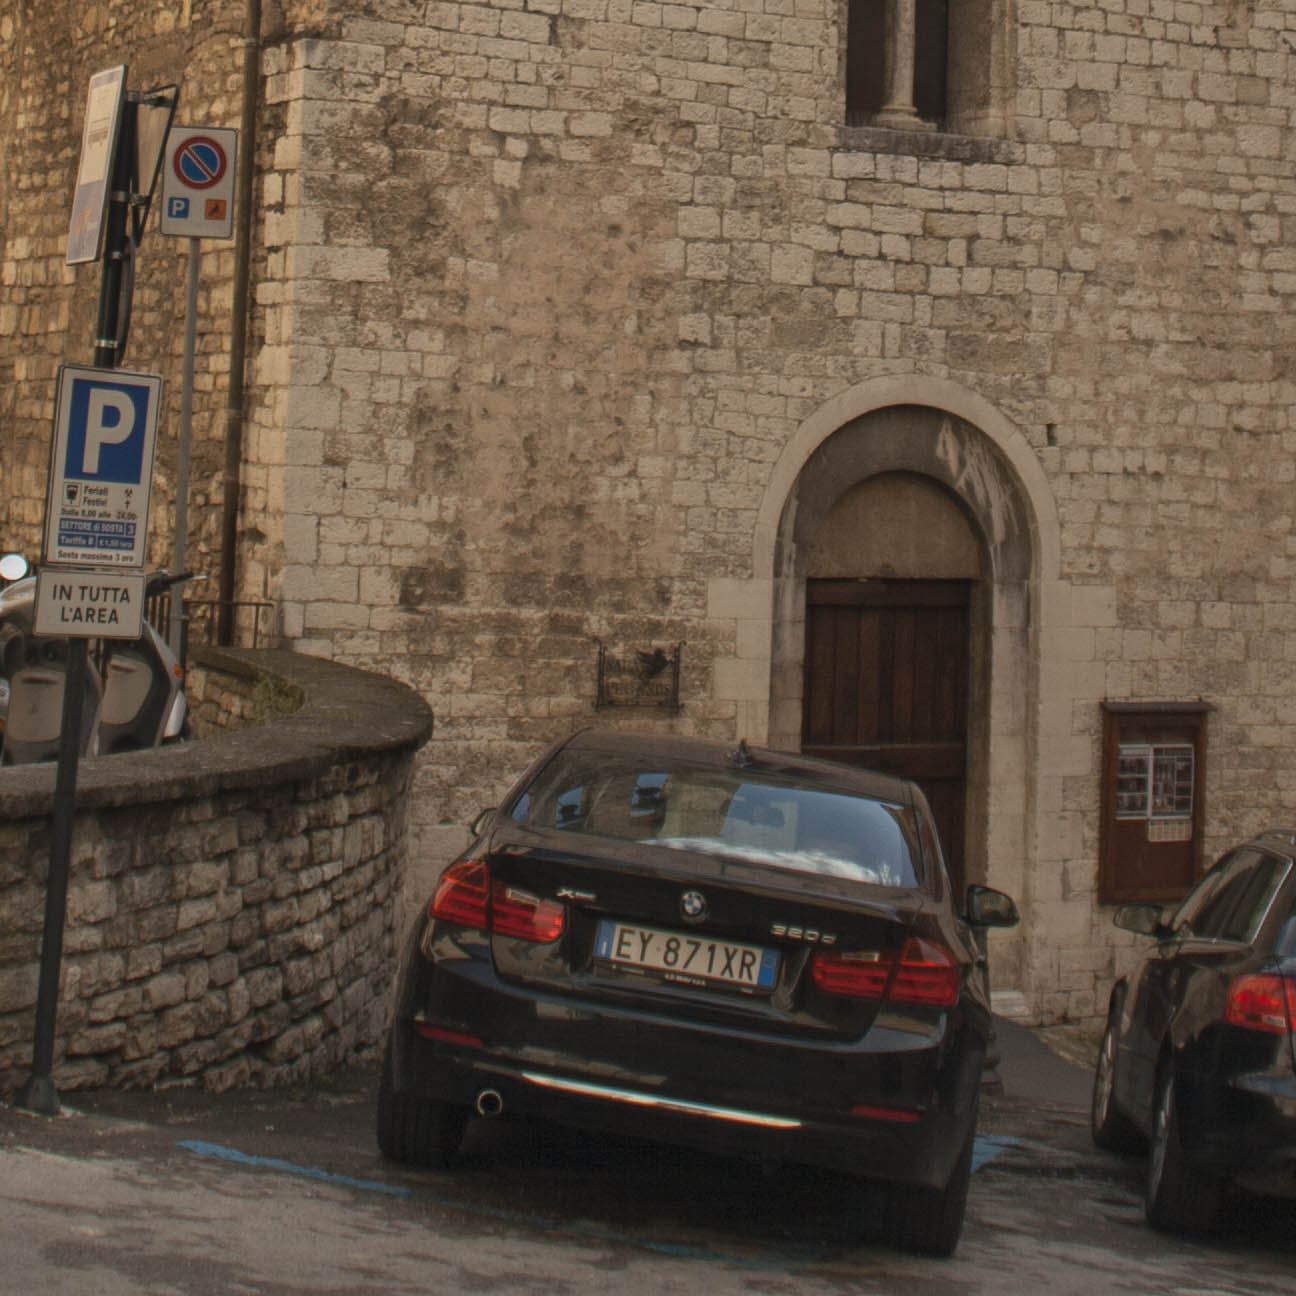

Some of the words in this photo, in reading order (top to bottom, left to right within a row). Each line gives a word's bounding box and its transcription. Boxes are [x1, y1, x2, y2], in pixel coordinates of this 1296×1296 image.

[171, 200, 185, 216] P
[82, 387, 136, 475] P
[83, 485, 109, 497] Feriali
[57, 549, 79, 560] Sosta
[80, 551, 113, 561] massima
[115, 552, 120, 561] 3
[52, 584, 73, 602] IN
[79, 585, 131, 604] TUTTA
[60, 606, 119, 625] L'AREA
[615, 927, 655, 962] EY
[662, 935, 758, 982] 871XR
